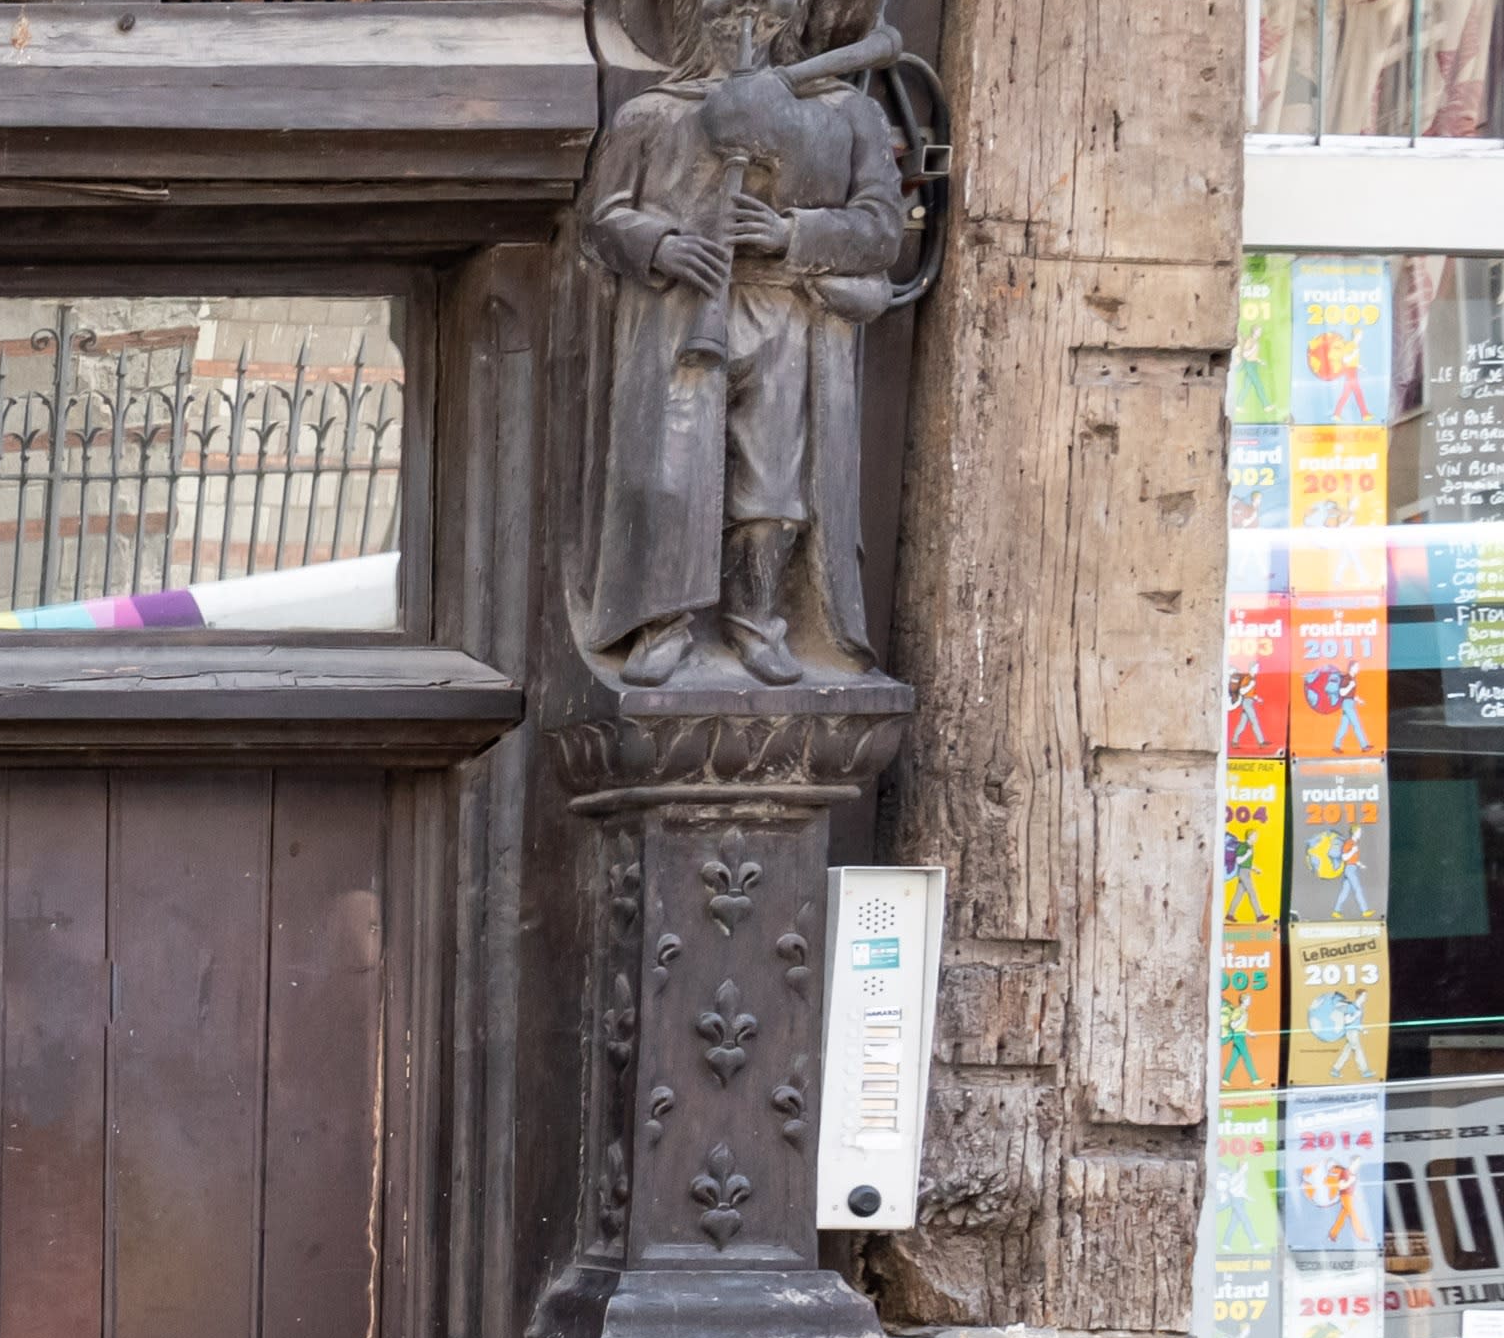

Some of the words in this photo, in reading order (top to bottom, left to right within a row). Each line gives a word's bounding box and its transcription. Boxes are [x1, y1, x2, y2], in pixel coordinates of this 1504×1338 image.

[1306, 304, 1380, 326] 2009
[1303, 474, 1375, 494] 2010
[1299, 619, 1378, 637] routard
[1303, 639, 1373, 660] 2011
[1302, 783, 1380, 803] routard
[1305, 804, 1378, 825] 2012
[1305, 963, 1379, 986] 2013
[1299, 1130, 1375, 1151] 2014
[1299, 1297, 1371, 1317] 2015
